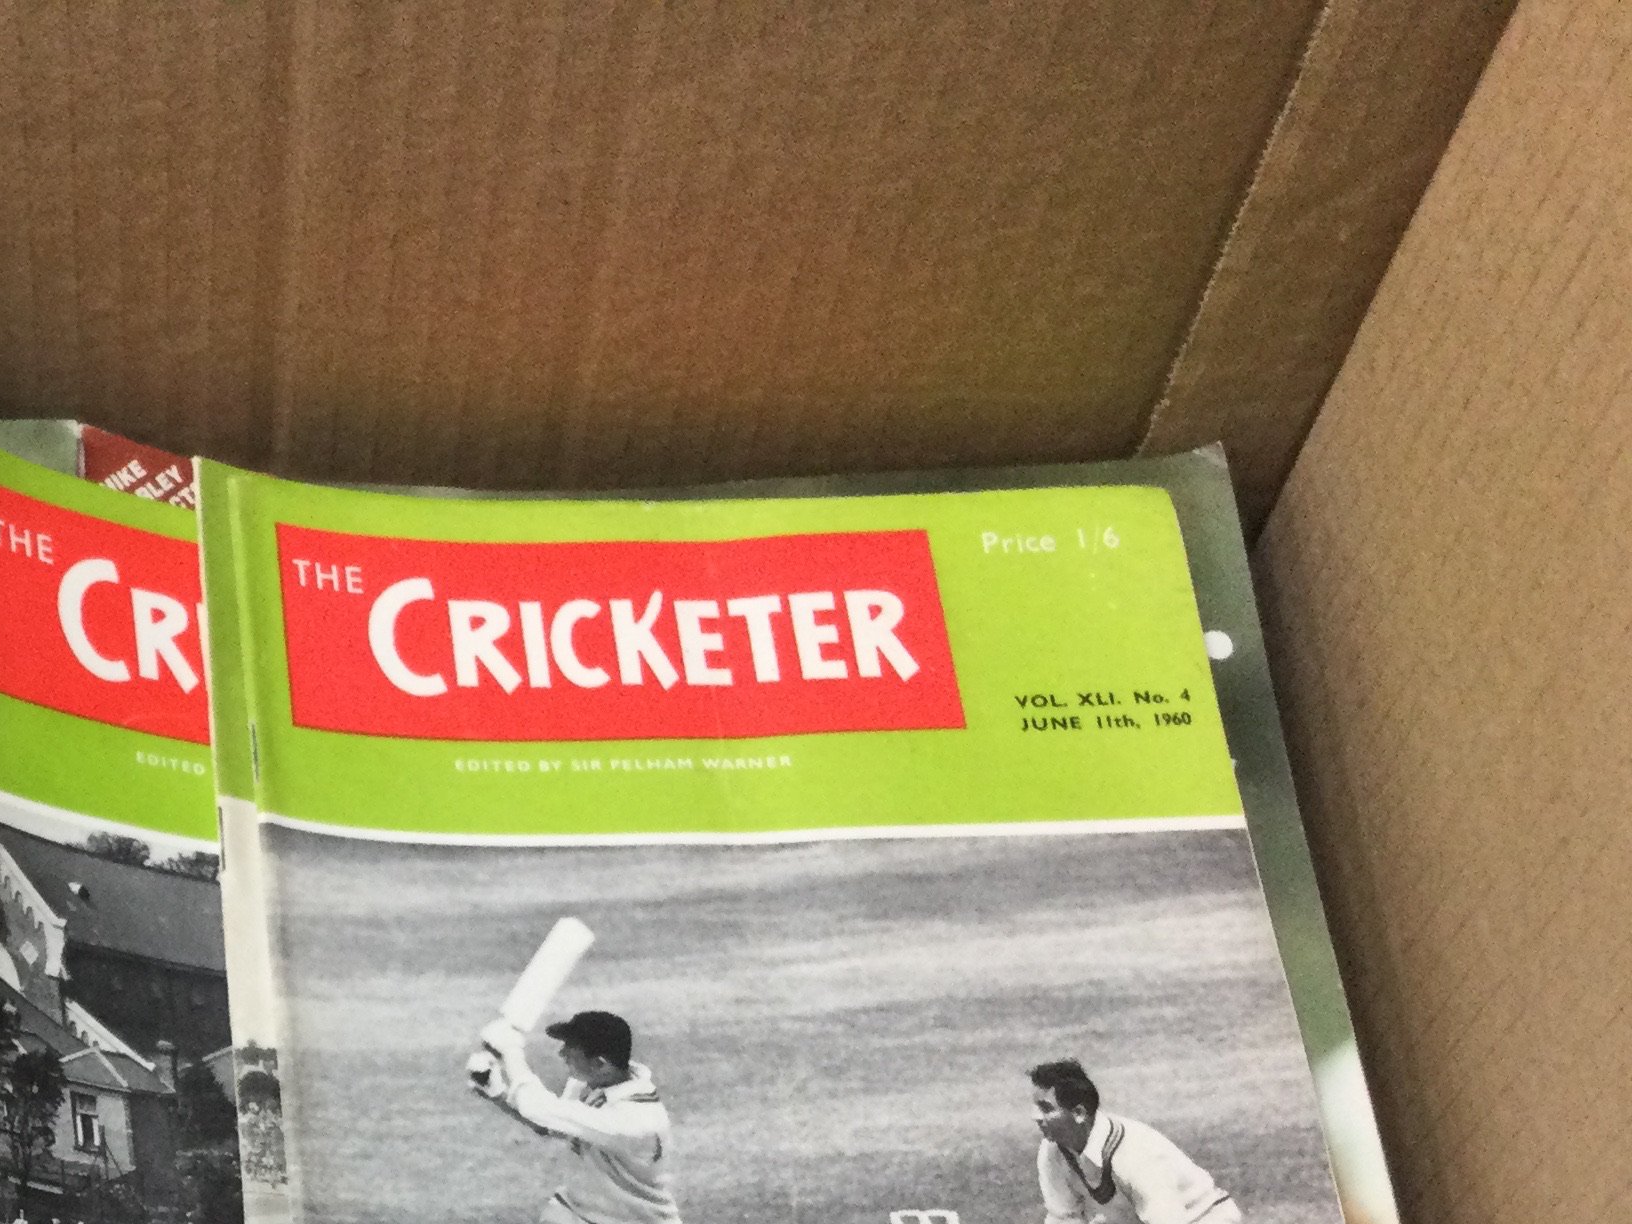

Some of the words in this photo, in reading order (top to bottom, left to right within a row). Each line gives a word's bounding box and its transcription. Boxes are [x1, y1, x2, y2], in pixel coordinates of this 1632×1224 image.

[981, 530, 1056, 553] Price
[293, 558, 364, 594] THE
[57, 558, 206, 694] CR
[1015, 693, 1067, 708] VOL.
[1077, 691, 1121, 707] XLI.
[1133, 690, 1169, 704] No.
[1180, 687, 1191, 701] 4
[1021, 716, 1082, 732] JUNE
[1097, 714, 1141, 729] 11th,
[1154, 711, 1192, 727] 1960
[135, 750, 206, 776] EDITED
[455, 758, 530, 773] EDITED
[539, 759, 561, 772] BY
[571, 758, 601, 771] SIR
[610, 756, 693, 770] PELHAM
[702, 754, 792, 770] WARNER
